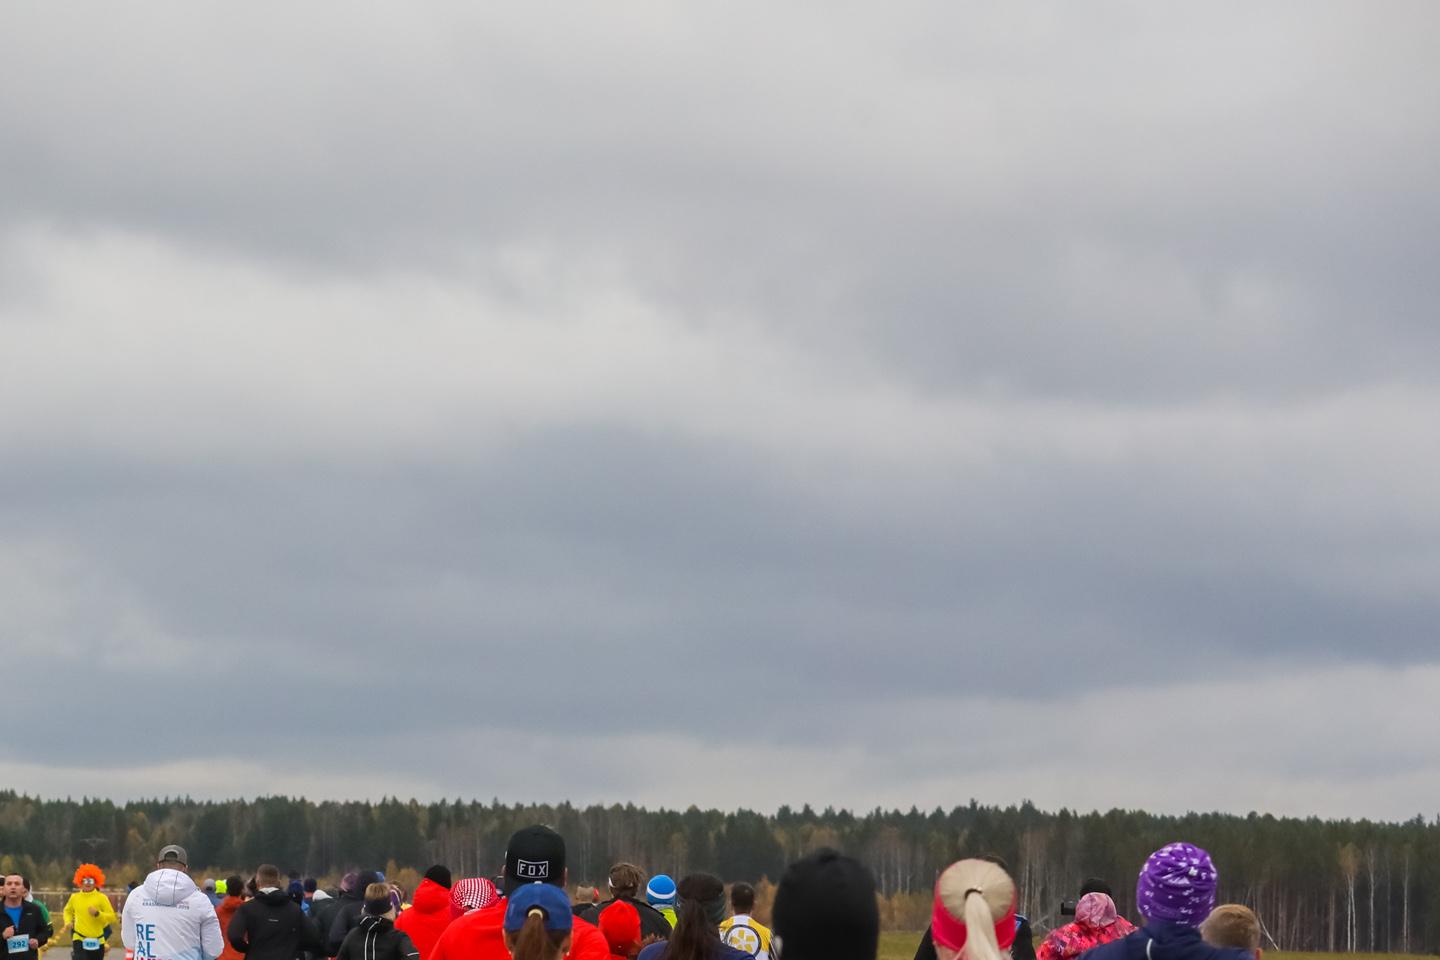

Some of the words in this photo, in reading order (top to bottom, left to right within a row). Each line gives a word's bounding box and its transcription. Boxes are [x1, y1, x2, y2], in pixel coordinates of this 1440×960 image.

[519, 863, 546, 876] FOX
[136, 923, 156, 941] RE
[12, 940, 26, 949] 292
[137, 941, 156, 958] AL
